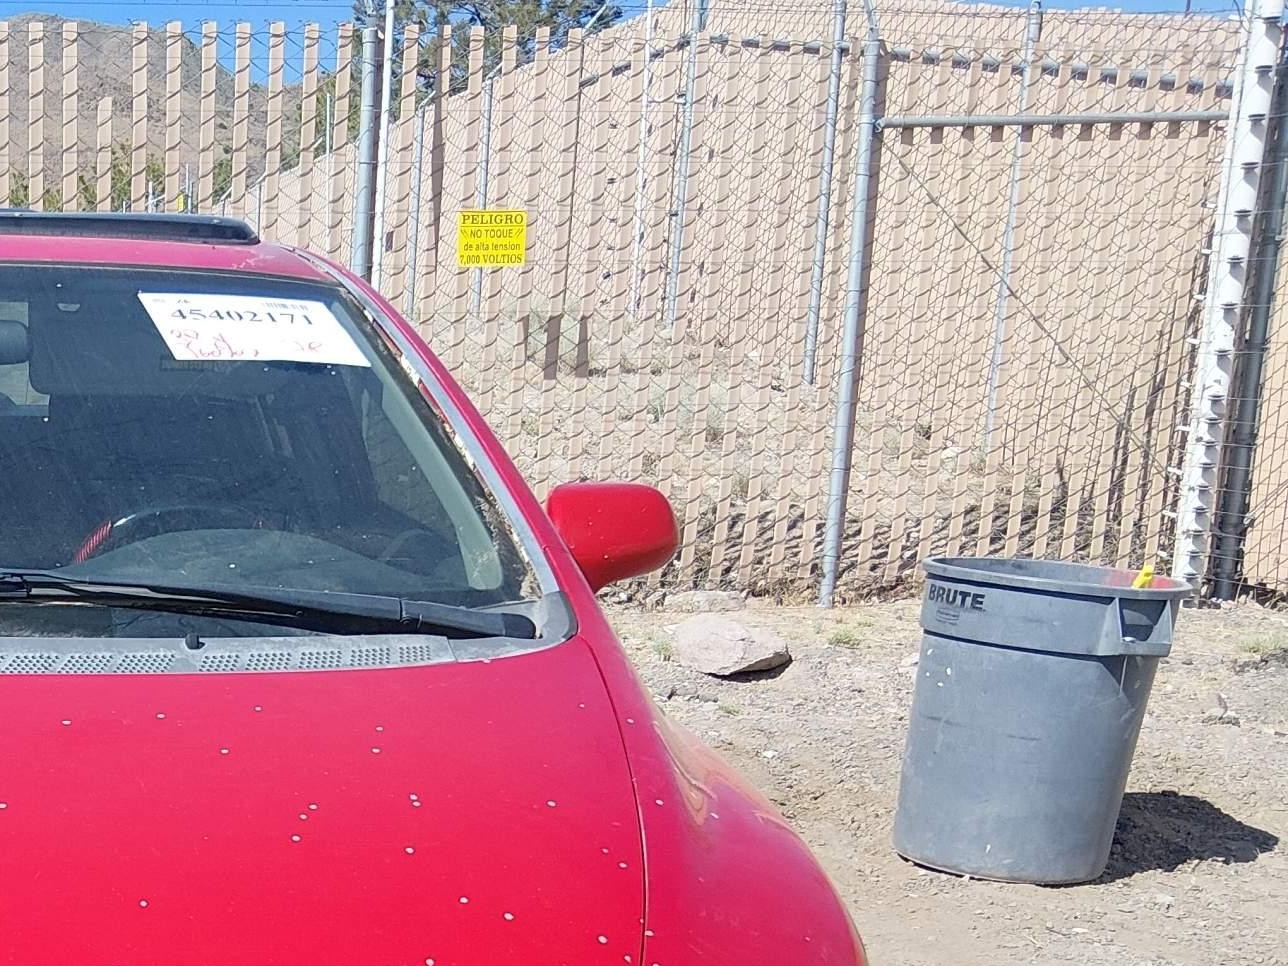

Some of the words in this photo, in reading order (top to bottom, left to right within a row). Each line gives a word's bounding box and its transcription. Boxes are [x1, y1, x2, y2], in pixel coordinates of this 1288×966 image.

[462, 213, 524, 225] PELIGRO
[470, 228, 482, 239] NO
[484, 228, 513, 239] TOQUE
[463, 241, 473, 251] de
[475, 241, 489, 251] alta
[460, 254, 481, 265] 7,000
[482, 253, 522, 264] VOLTIOS
[171, 308, 313, 325] 45402171
[928, 583, 986, 612] BRUTE
